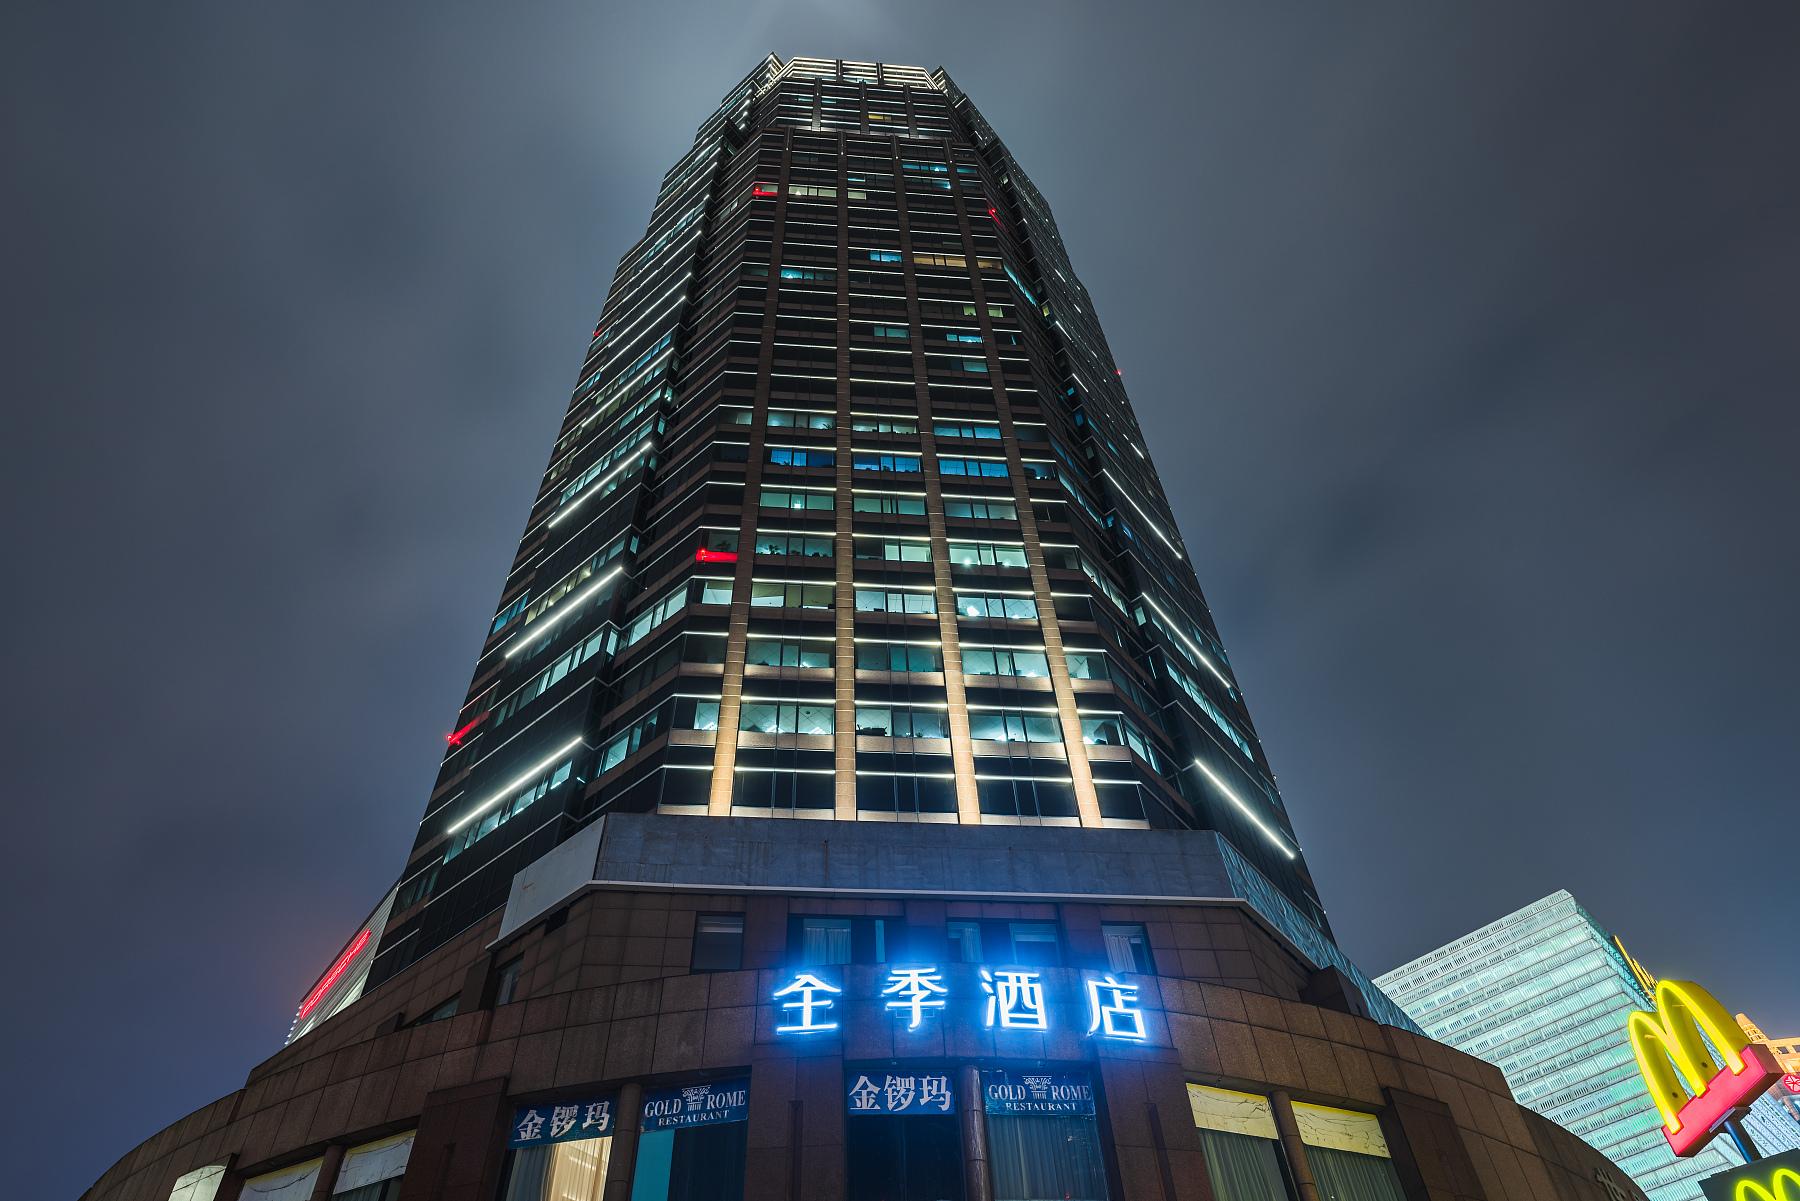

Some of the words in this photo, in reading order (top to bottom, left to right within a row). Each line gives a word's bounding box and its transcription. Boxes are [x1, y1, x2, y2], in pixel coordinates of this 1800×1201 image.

[774, 967, 1147, 1040] 全季酒店
[644, 1098, 682, 1118] GOLD
[706, 1090, 746, 1110] ROME
[848, 1074, 952, 1112] 金锣玛
[988, 1084, 1026, 1101] GOLD
[1052, 1084, 1092, 1101] ROME
[1005, 1102, 1077, 1111] RESTAURANT
[513, 1100, 611, 1142] 金锣玛
[658, 1109, 730, 1127] RESTAURANT
